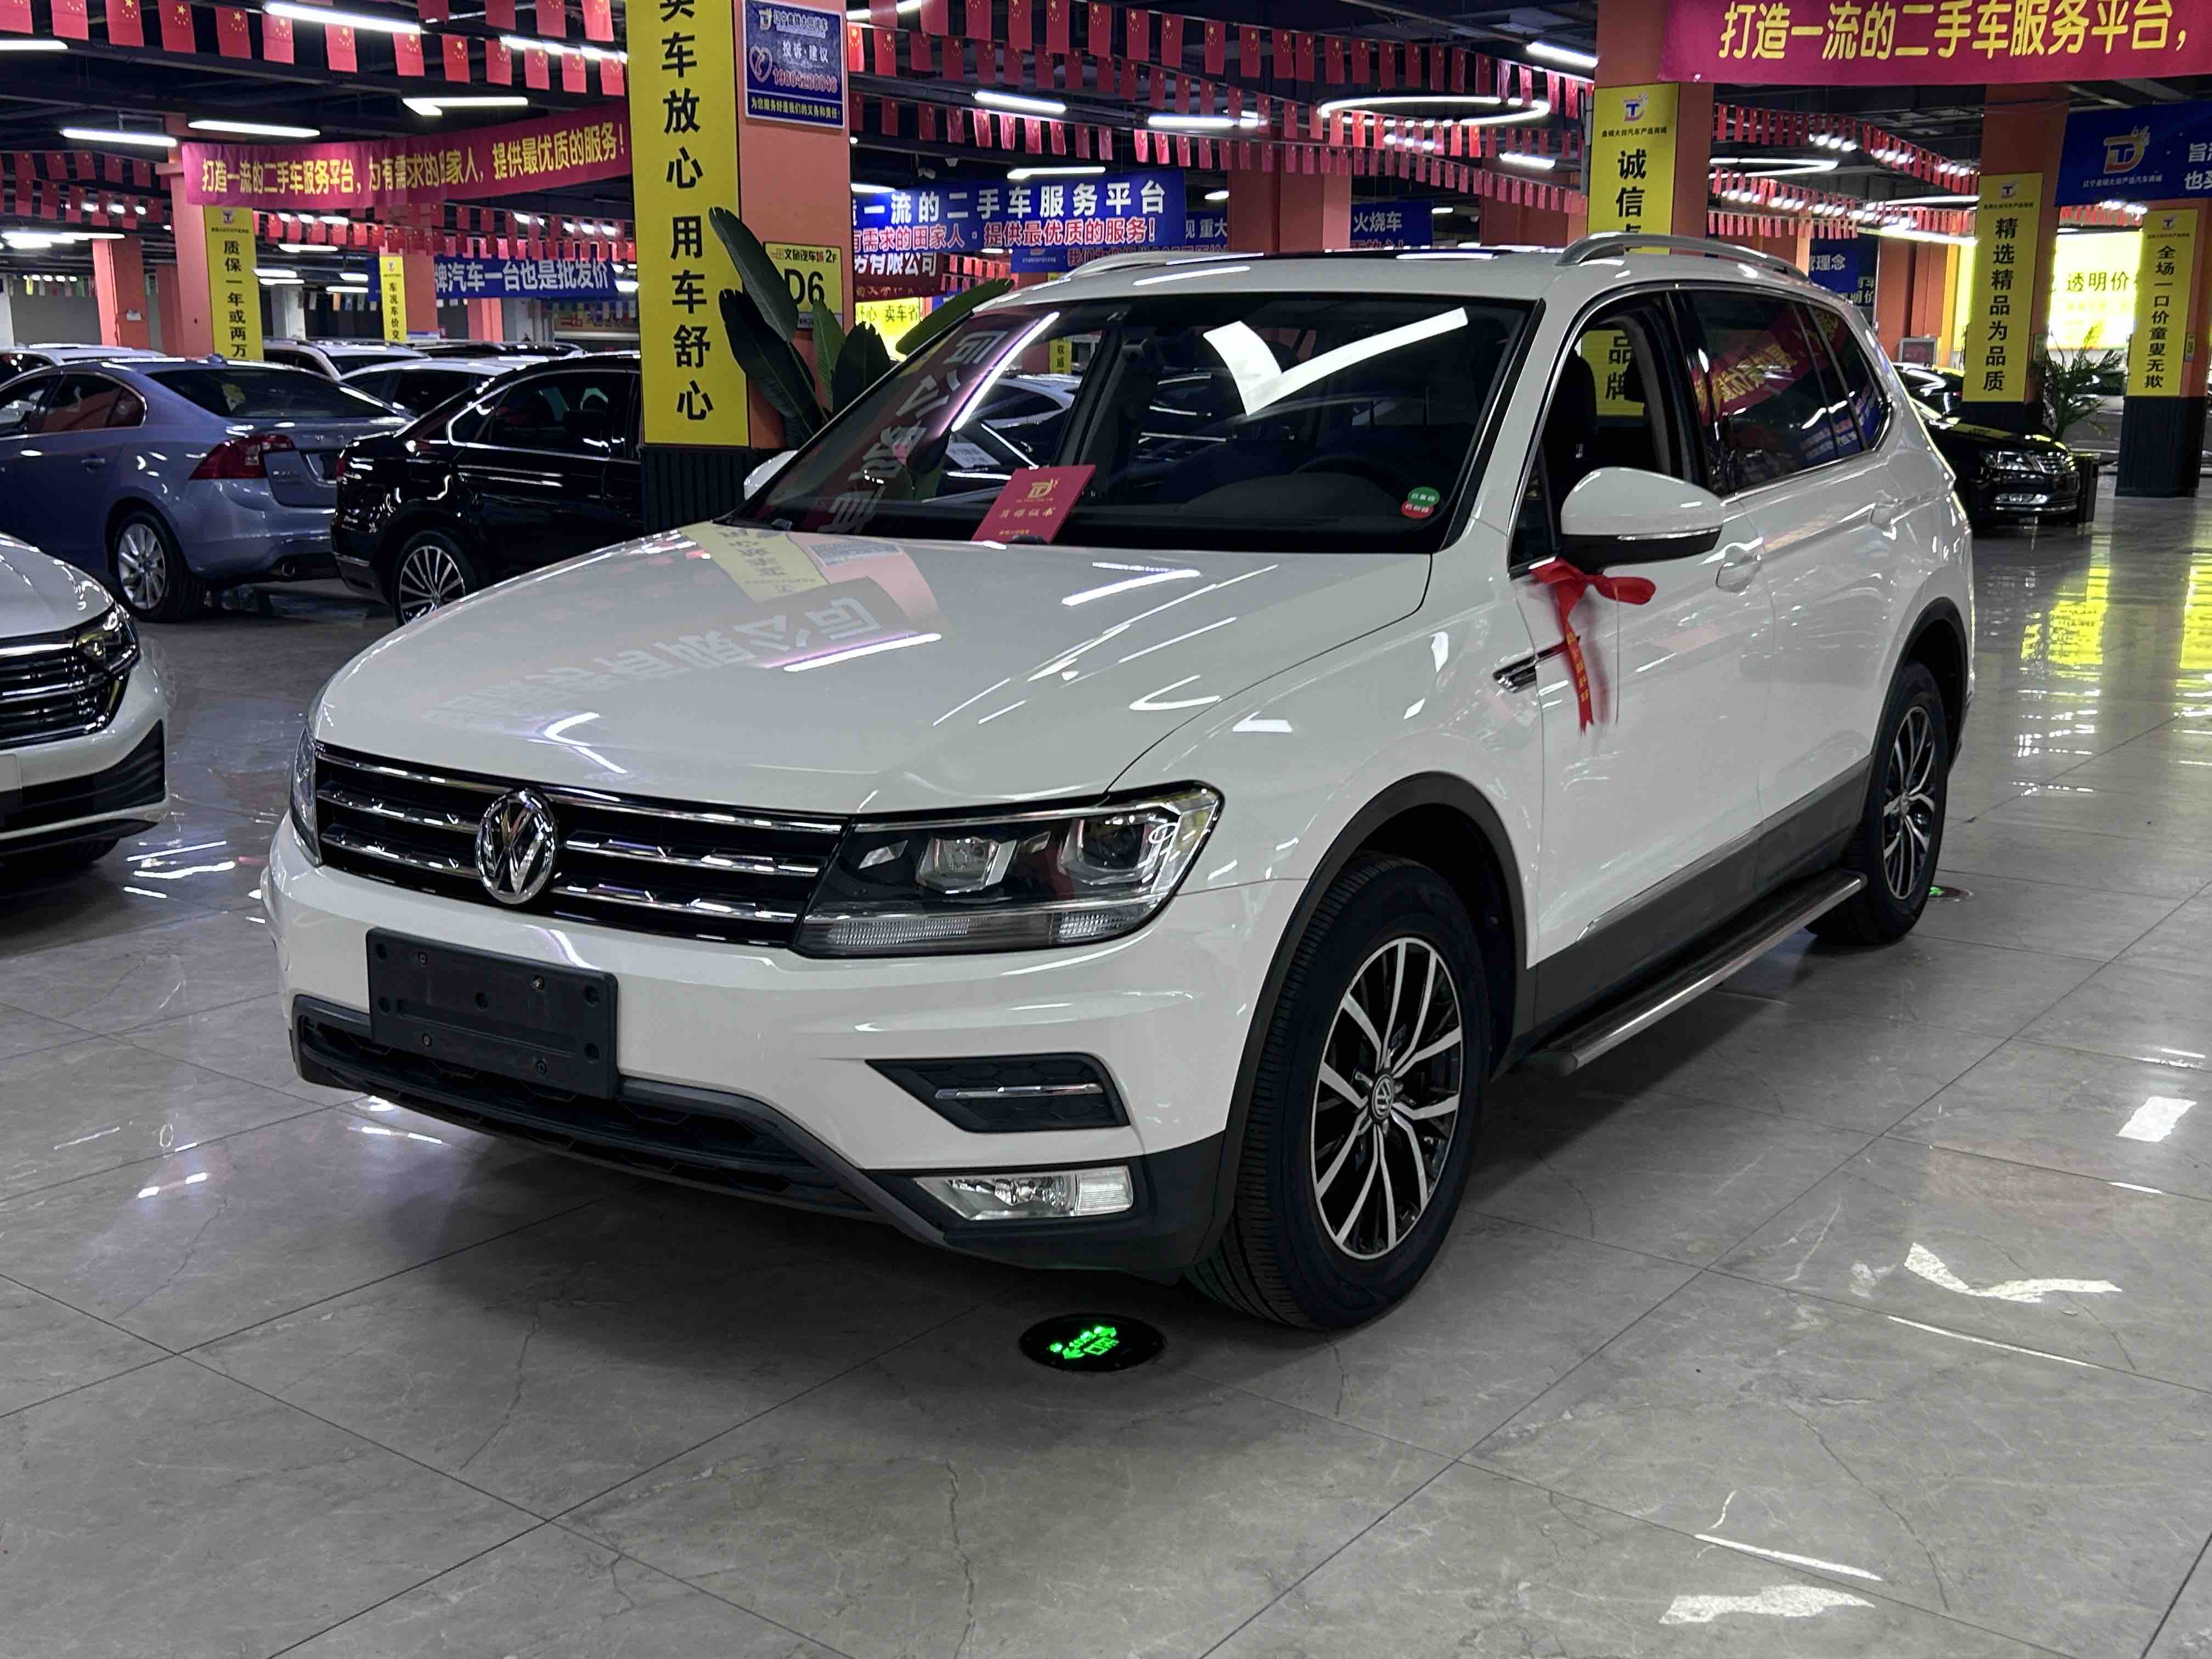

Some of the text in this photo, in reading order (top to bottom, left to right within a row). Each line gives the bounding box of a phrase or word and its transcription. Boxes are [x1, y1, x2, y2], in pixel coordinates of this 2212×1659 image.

[1718, 0, 2187, 60] 打造一流的二手车服务平台，
[1353, 211, 1402, 233] 火烧车
[224, 240, 247, 358] 质保一年或两万
[785, 268, 825, 305] D6
[1983, 217, 2018, 392] 精选精品为品质
[2145, 245, 2176, 388] 全场一口价童叟无欺
